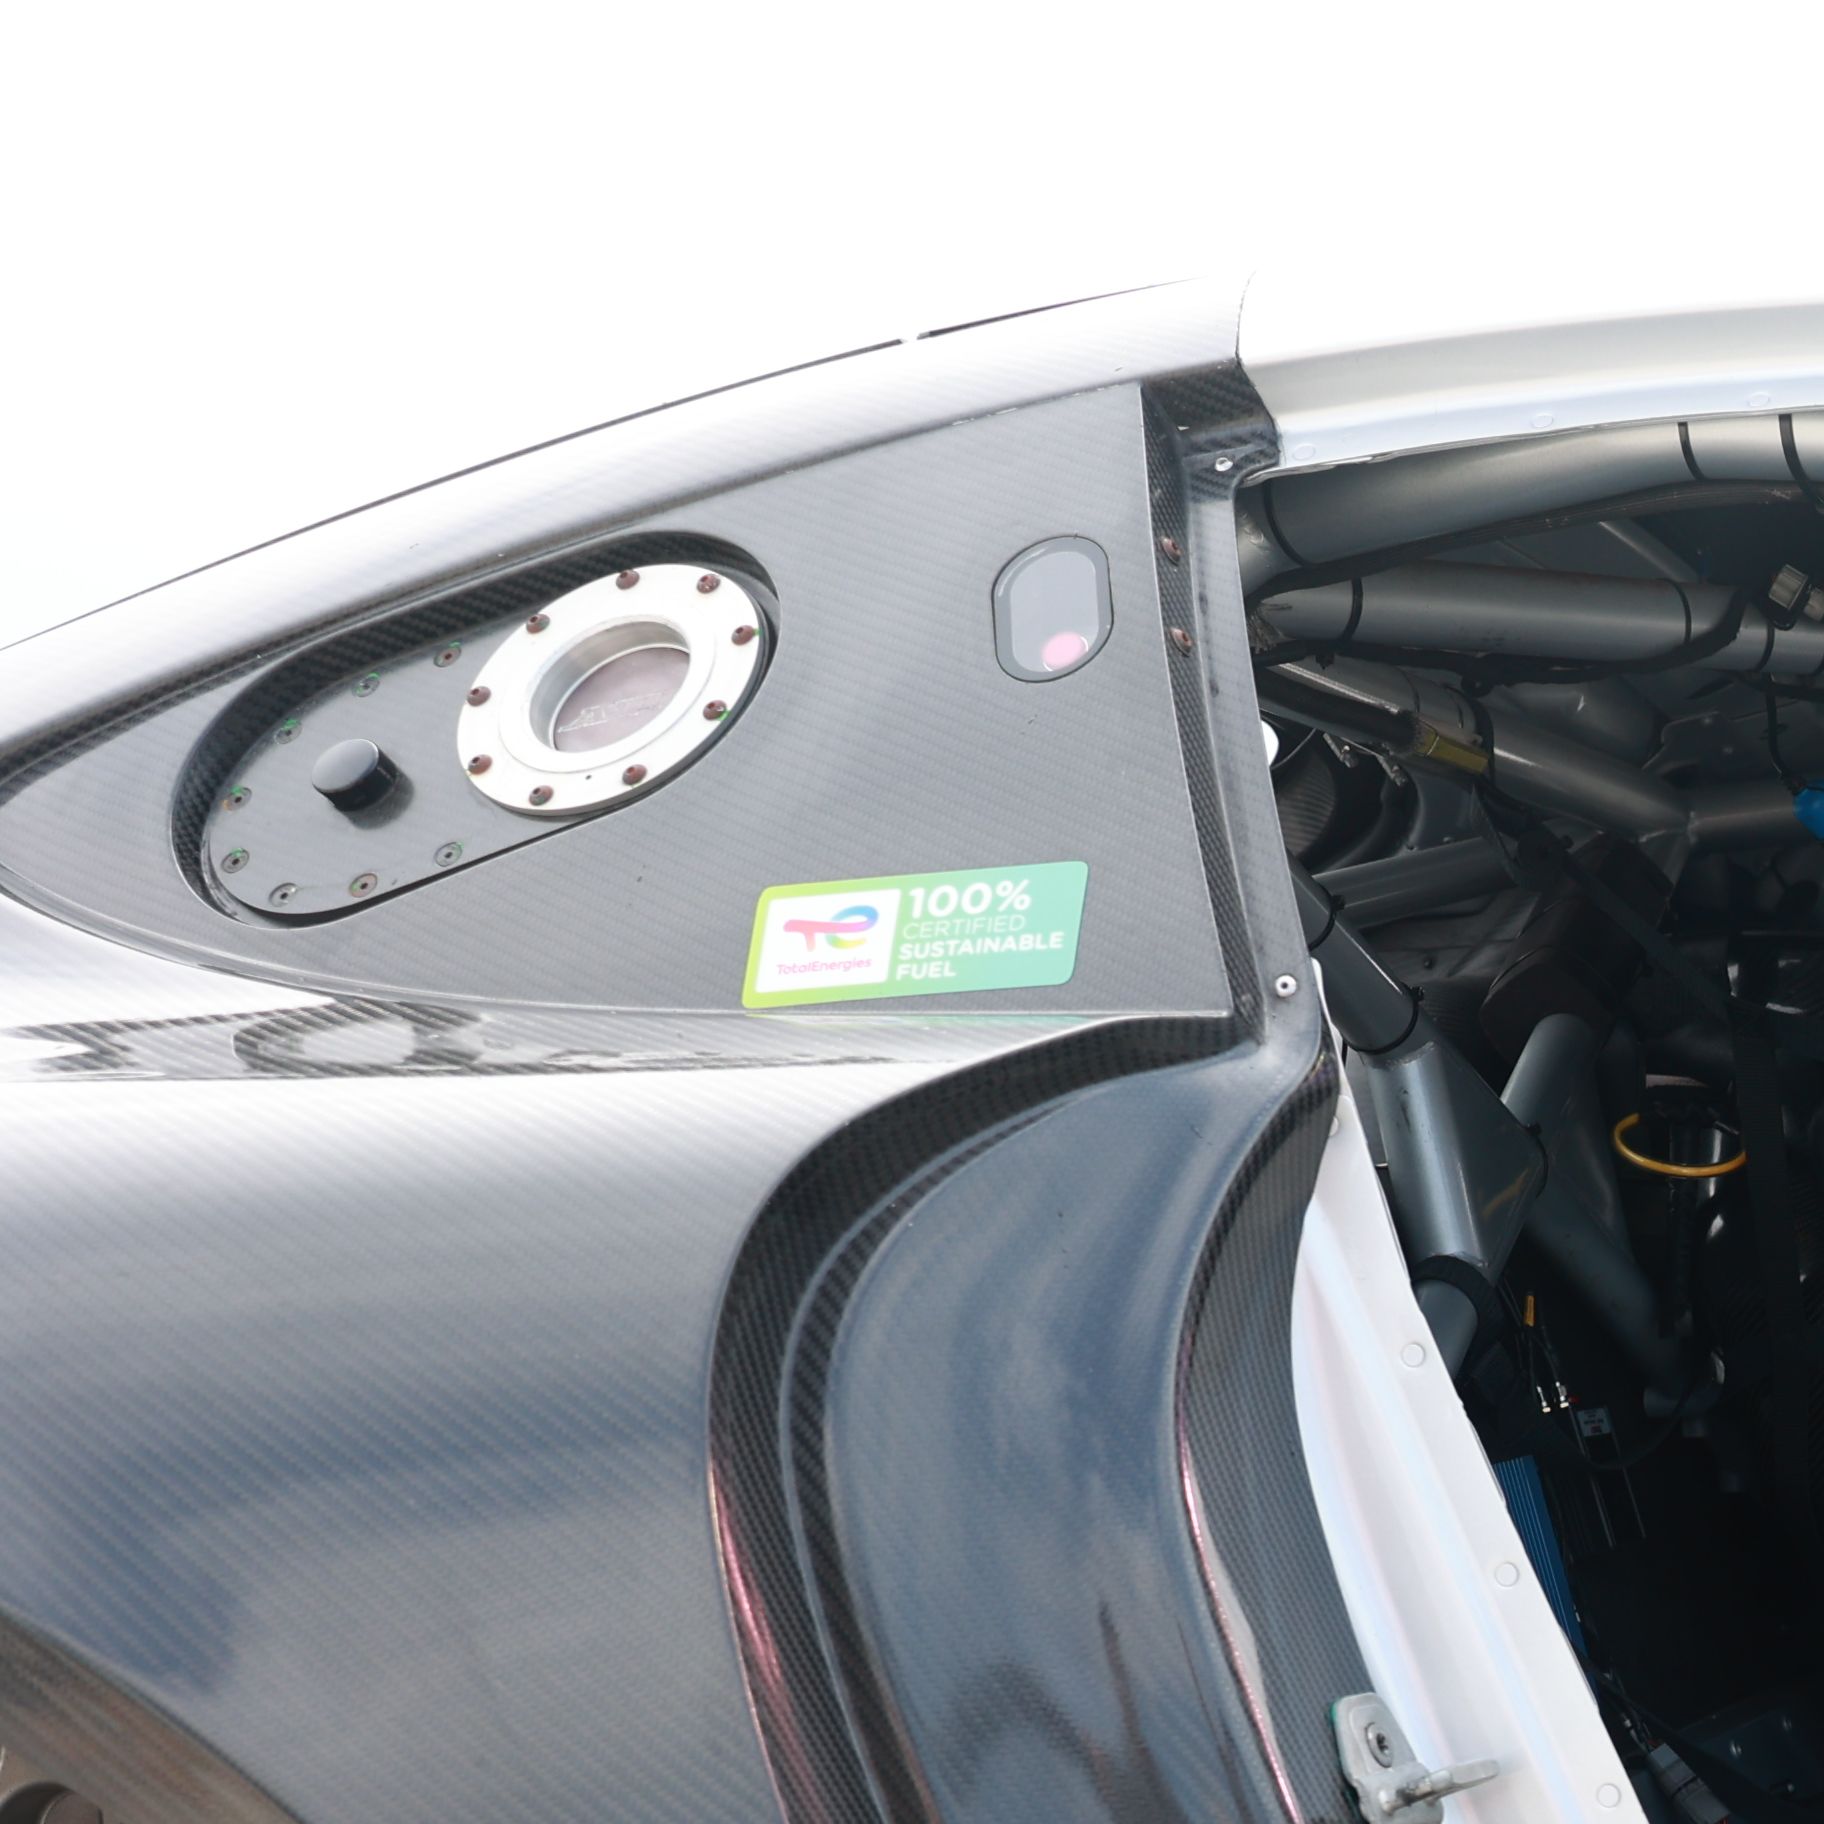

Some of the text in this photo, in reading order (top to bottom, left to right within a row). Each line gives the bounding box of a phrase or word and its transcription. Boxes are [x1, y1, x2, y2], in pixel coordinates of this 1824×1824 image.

[909, 879, 1032, 920] 100%
[902, 913, 1027, 941] CERTIFIED
[897, 930, 1065, 961] SUSTAINABLE
[776, 956, 873, 976] TotalEnergies
[895, 959, 957, 981] FUEL
